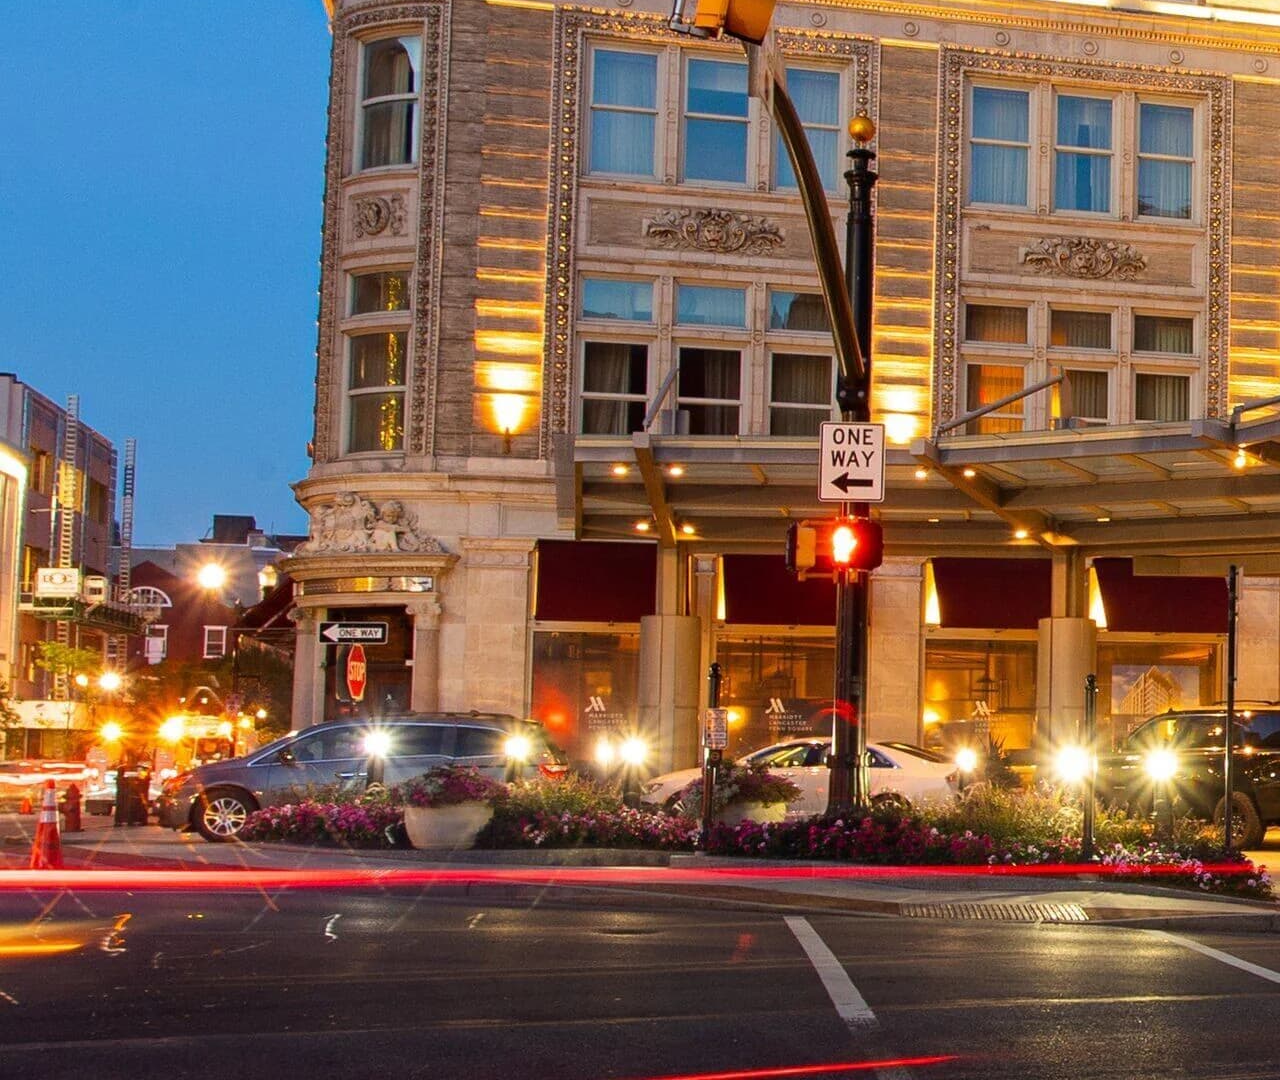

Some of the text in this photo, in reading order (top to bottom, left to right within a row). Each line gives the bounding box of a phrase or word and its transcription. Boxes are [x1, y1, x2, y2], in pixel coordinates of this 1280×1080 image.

[832, 428, 873, 445] ONE
[831, 450, 874, 467] WAY
[339, 629, 380, 638] ONE WAY
[349, 661, 366, 682] STOP
